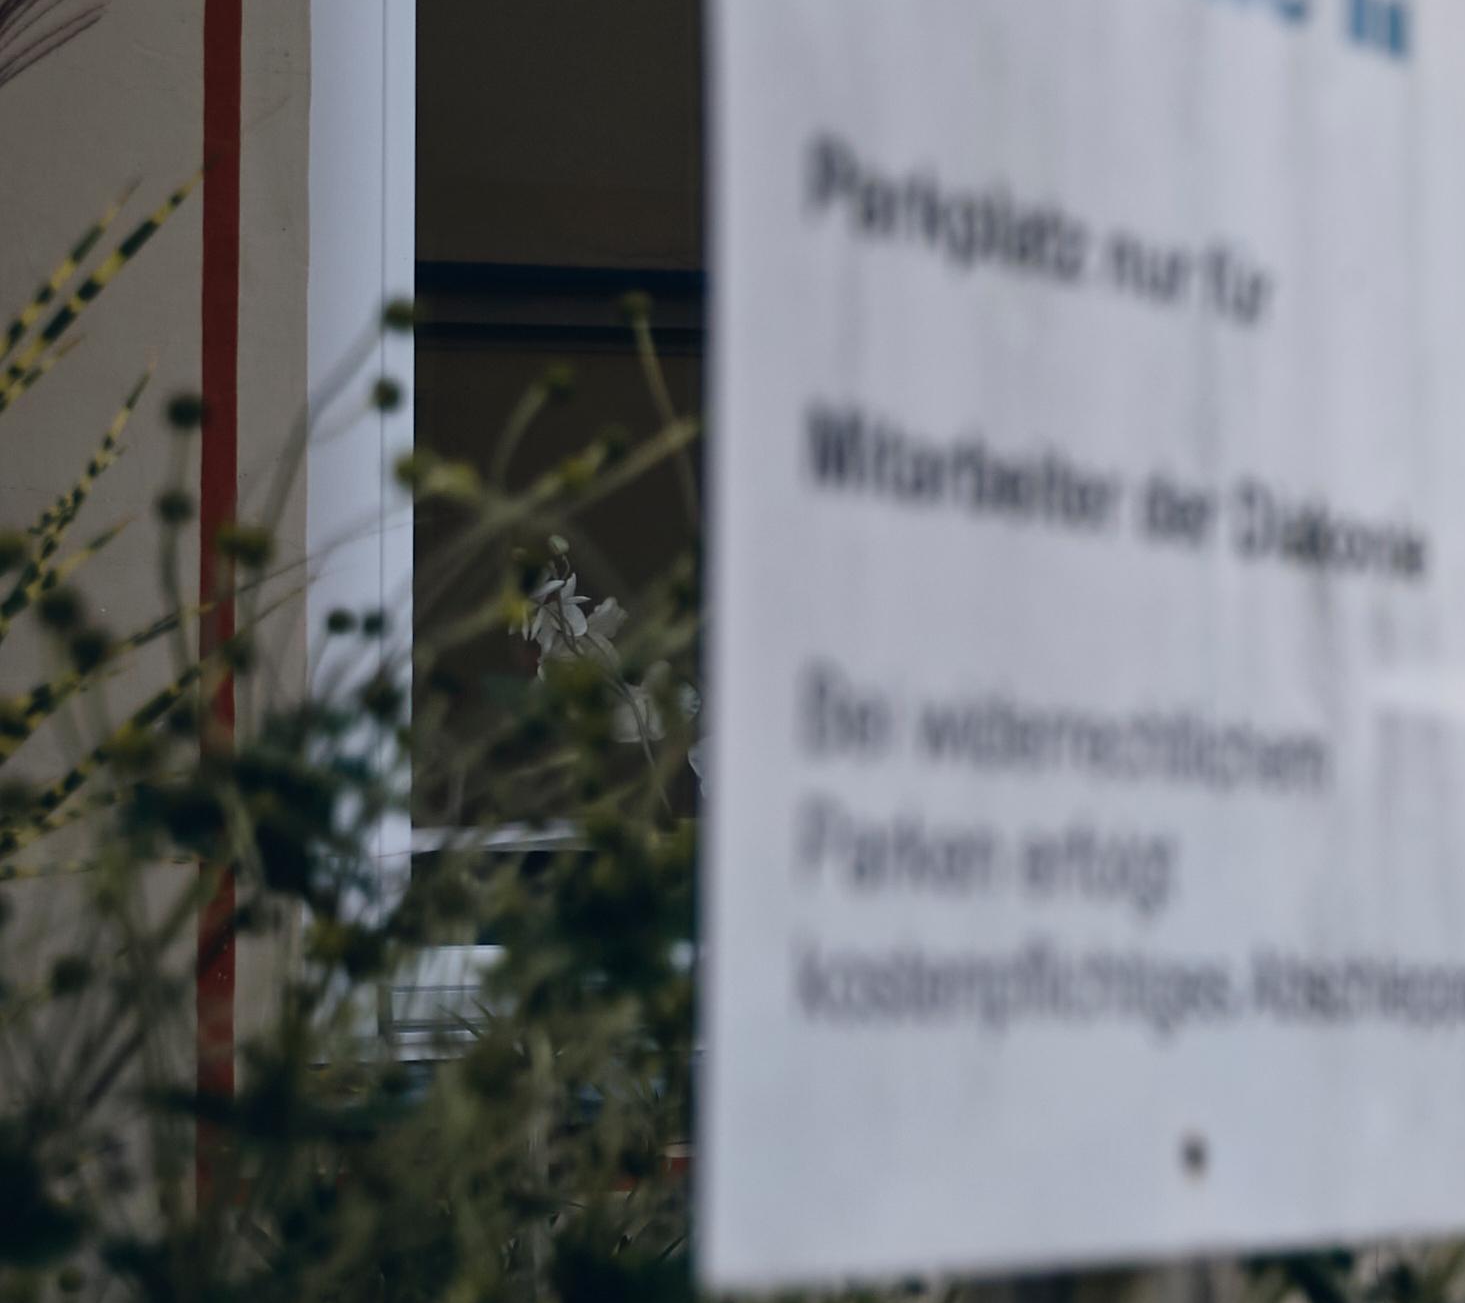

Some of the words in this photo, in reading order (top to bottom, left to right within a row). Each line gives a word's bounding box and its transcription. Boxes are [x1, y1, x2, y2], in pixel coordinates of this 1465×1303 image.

[808, 133, 1090, 286] Parkplatz
[1108, 230, 1193, 306] nur
[806, 403, 1125, 533] Mitarbeiter
[1142, 463, 1216, 546] der
[1232, 475, 1430, 580] Diakonie
[798, 793, 996, 893] Parken
